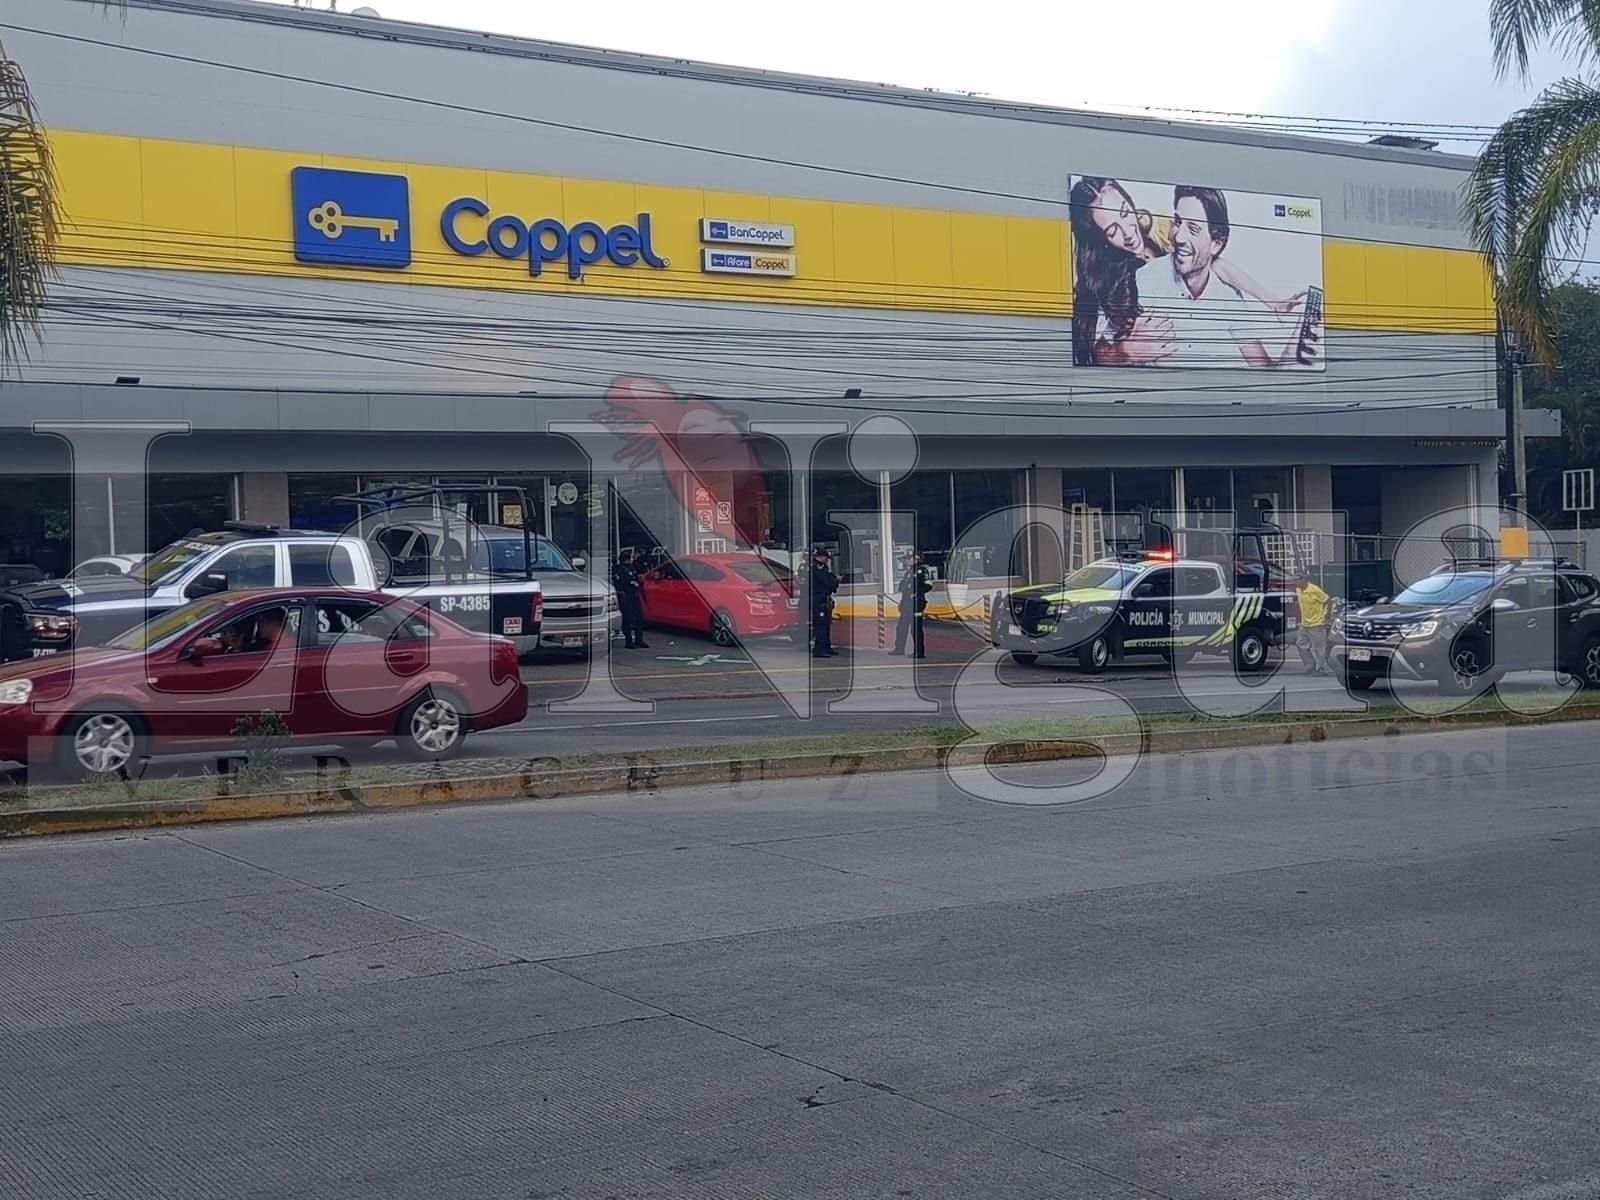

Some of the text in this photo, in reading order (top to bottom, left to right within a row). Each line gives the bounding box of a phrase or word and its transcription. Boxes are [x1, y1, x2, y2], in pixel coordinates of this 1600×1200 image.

[1287, 207, 1312, 219] Coppel
[440, 196, 664, 279] Coppel
[730, 225, 785, 242] BanCoppel
[727, 257, 786, 270] Afore Coppel
[440, 595, 491, 612] SP-4385
[1129, 607, 1164, 626] POLICÍA
[1187, 610, 1225, 626] MUNICIPAL
